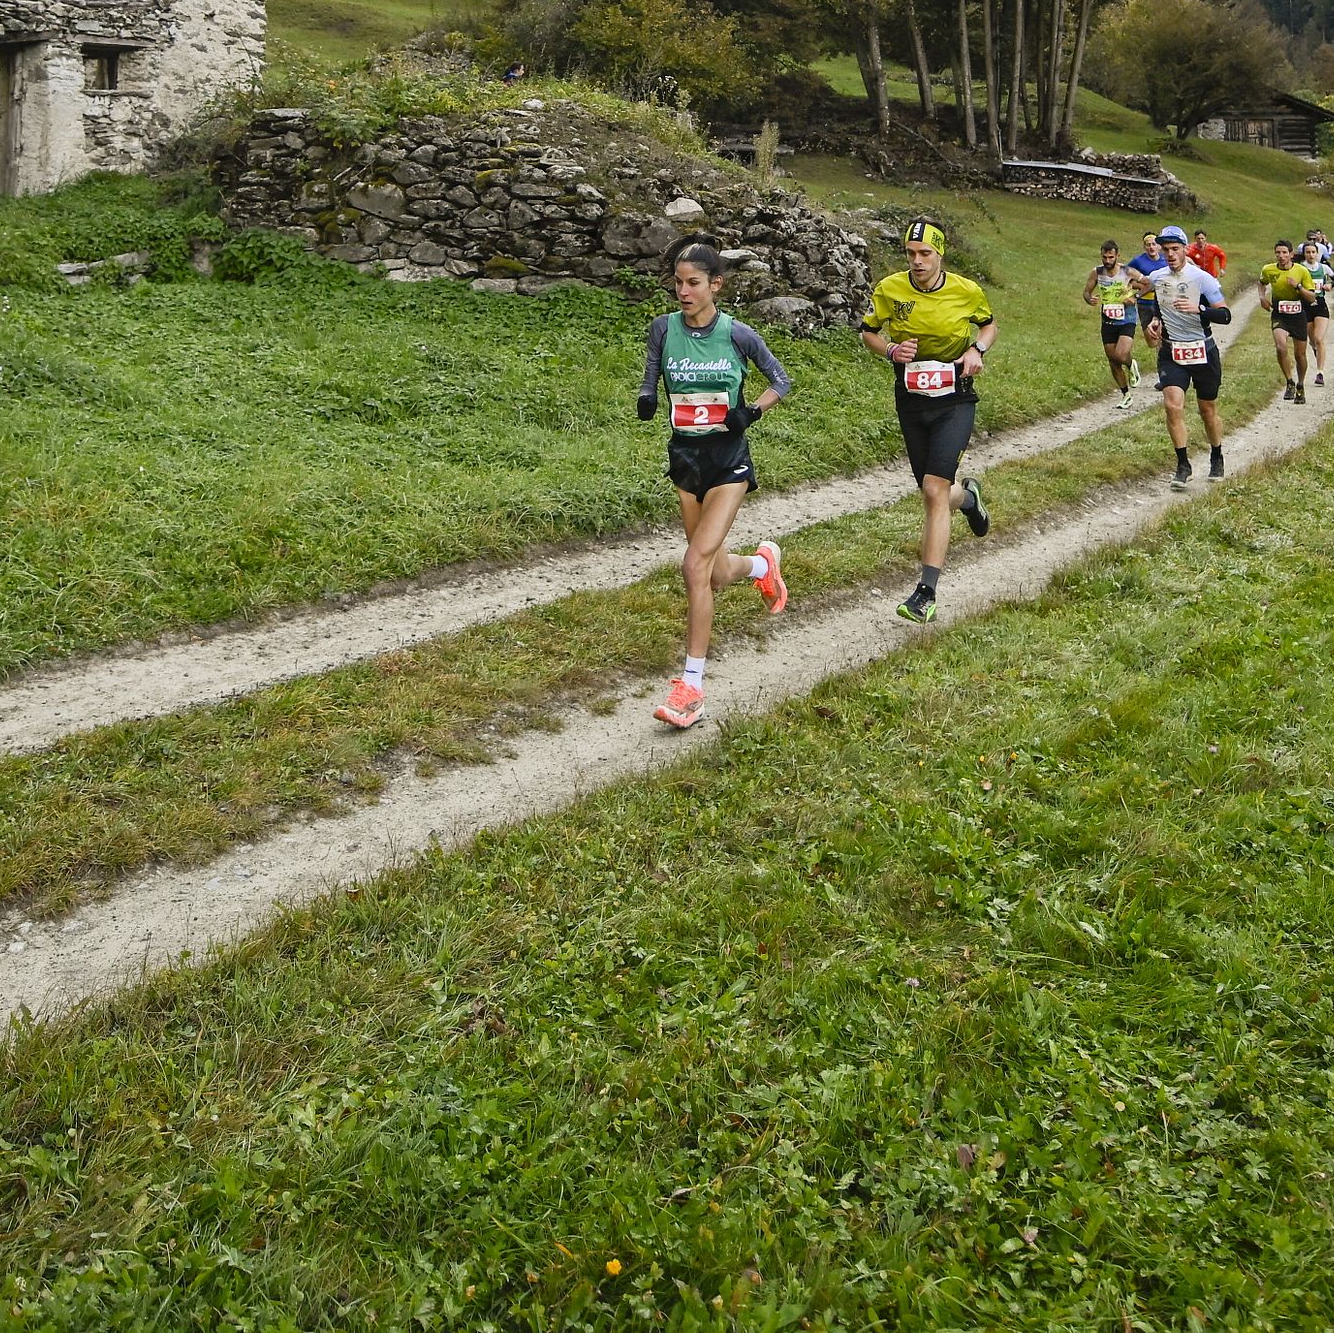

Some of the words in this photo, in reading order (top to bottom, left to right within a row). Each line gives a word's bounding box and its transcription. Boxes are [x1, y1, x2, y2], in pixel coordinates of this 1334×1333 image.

[1176, 348, 1202, 360] 134
[667, 357, 678, 369] La
[916, 372, 942, 389] 84
[693, 406, 709, 424] 2
